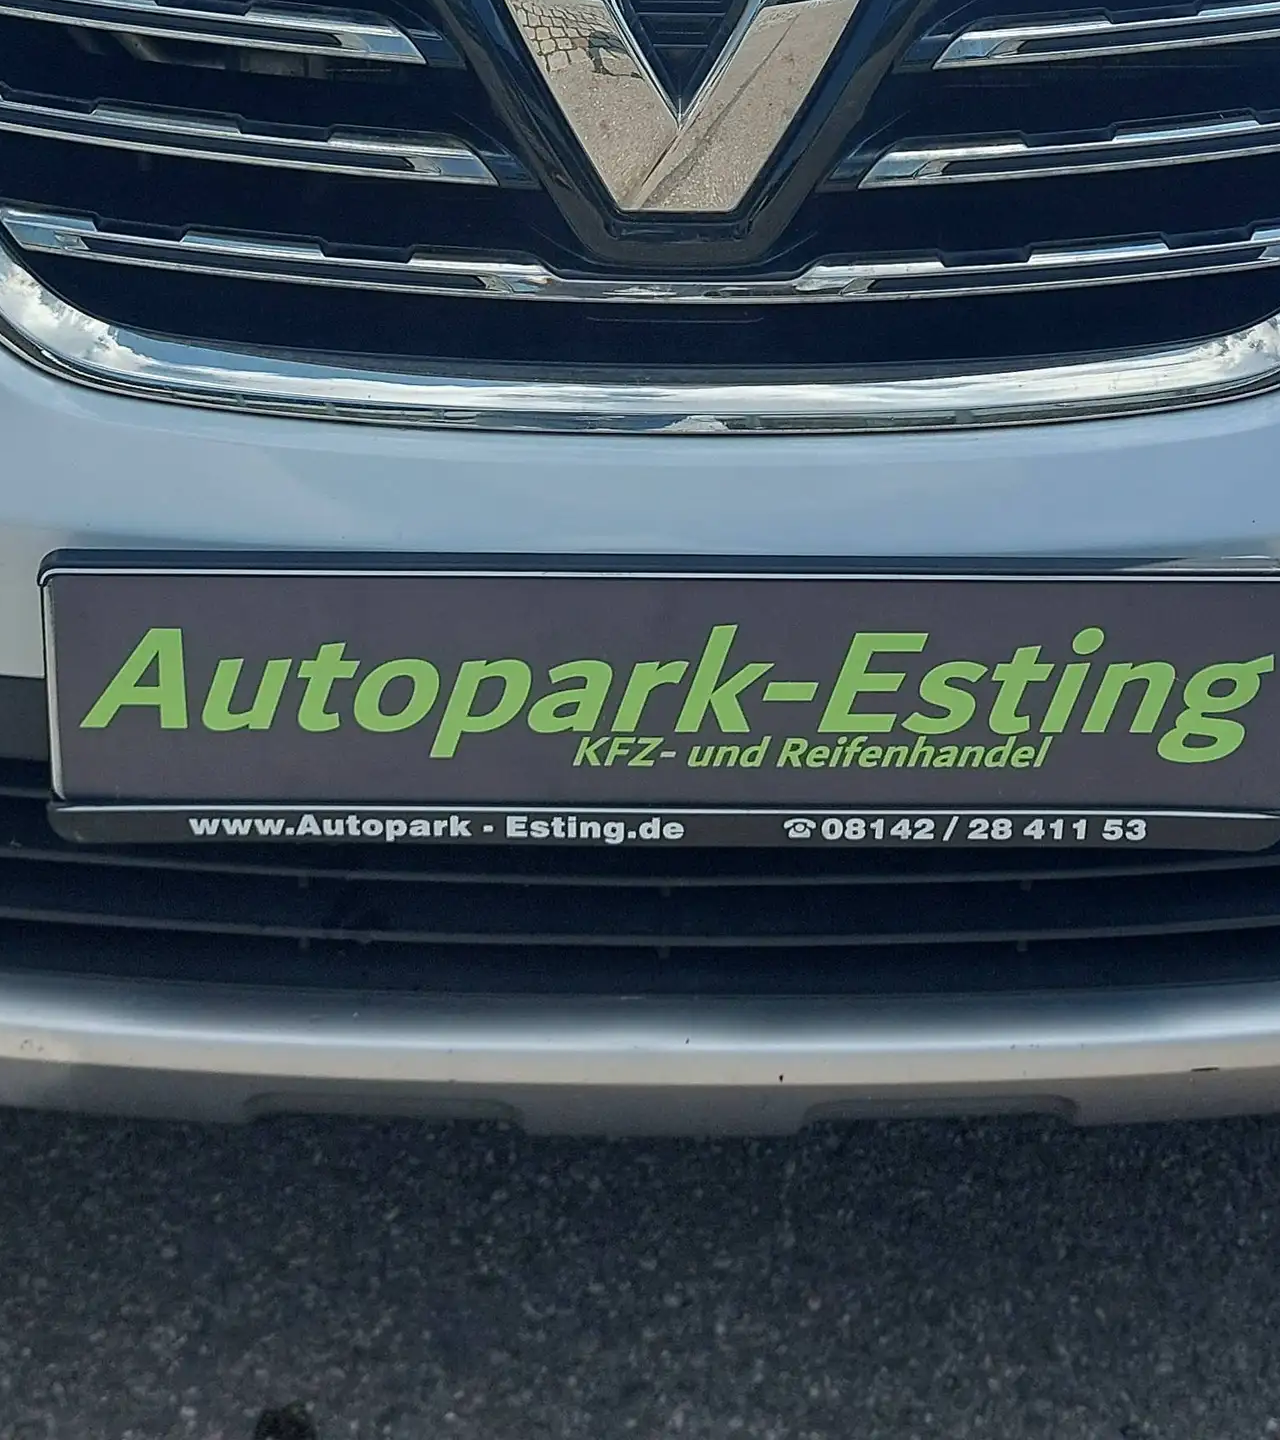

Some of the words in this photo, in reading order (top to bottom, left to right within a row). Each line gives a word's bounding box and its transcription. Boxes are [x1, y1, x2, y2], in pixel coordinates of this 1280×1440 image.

[79, 624, 1275, 763] Autopark-Esting
[572, 736, 677, 767] KFZ-
[687, 735, 772, 768] und
[776, 736, 1051, 769] Reifenhandel
[189, 814, 472, 841] www.Autopark
[506, 815, 685, 844] Esting.de
[821, 818, 935, 841] 08142
[942, 816, 959, 841] /
[967, 818, 1013, 841] 28
[1023, 819, 1087, 841] 411
[1102, 819, 1147, 841] 53
